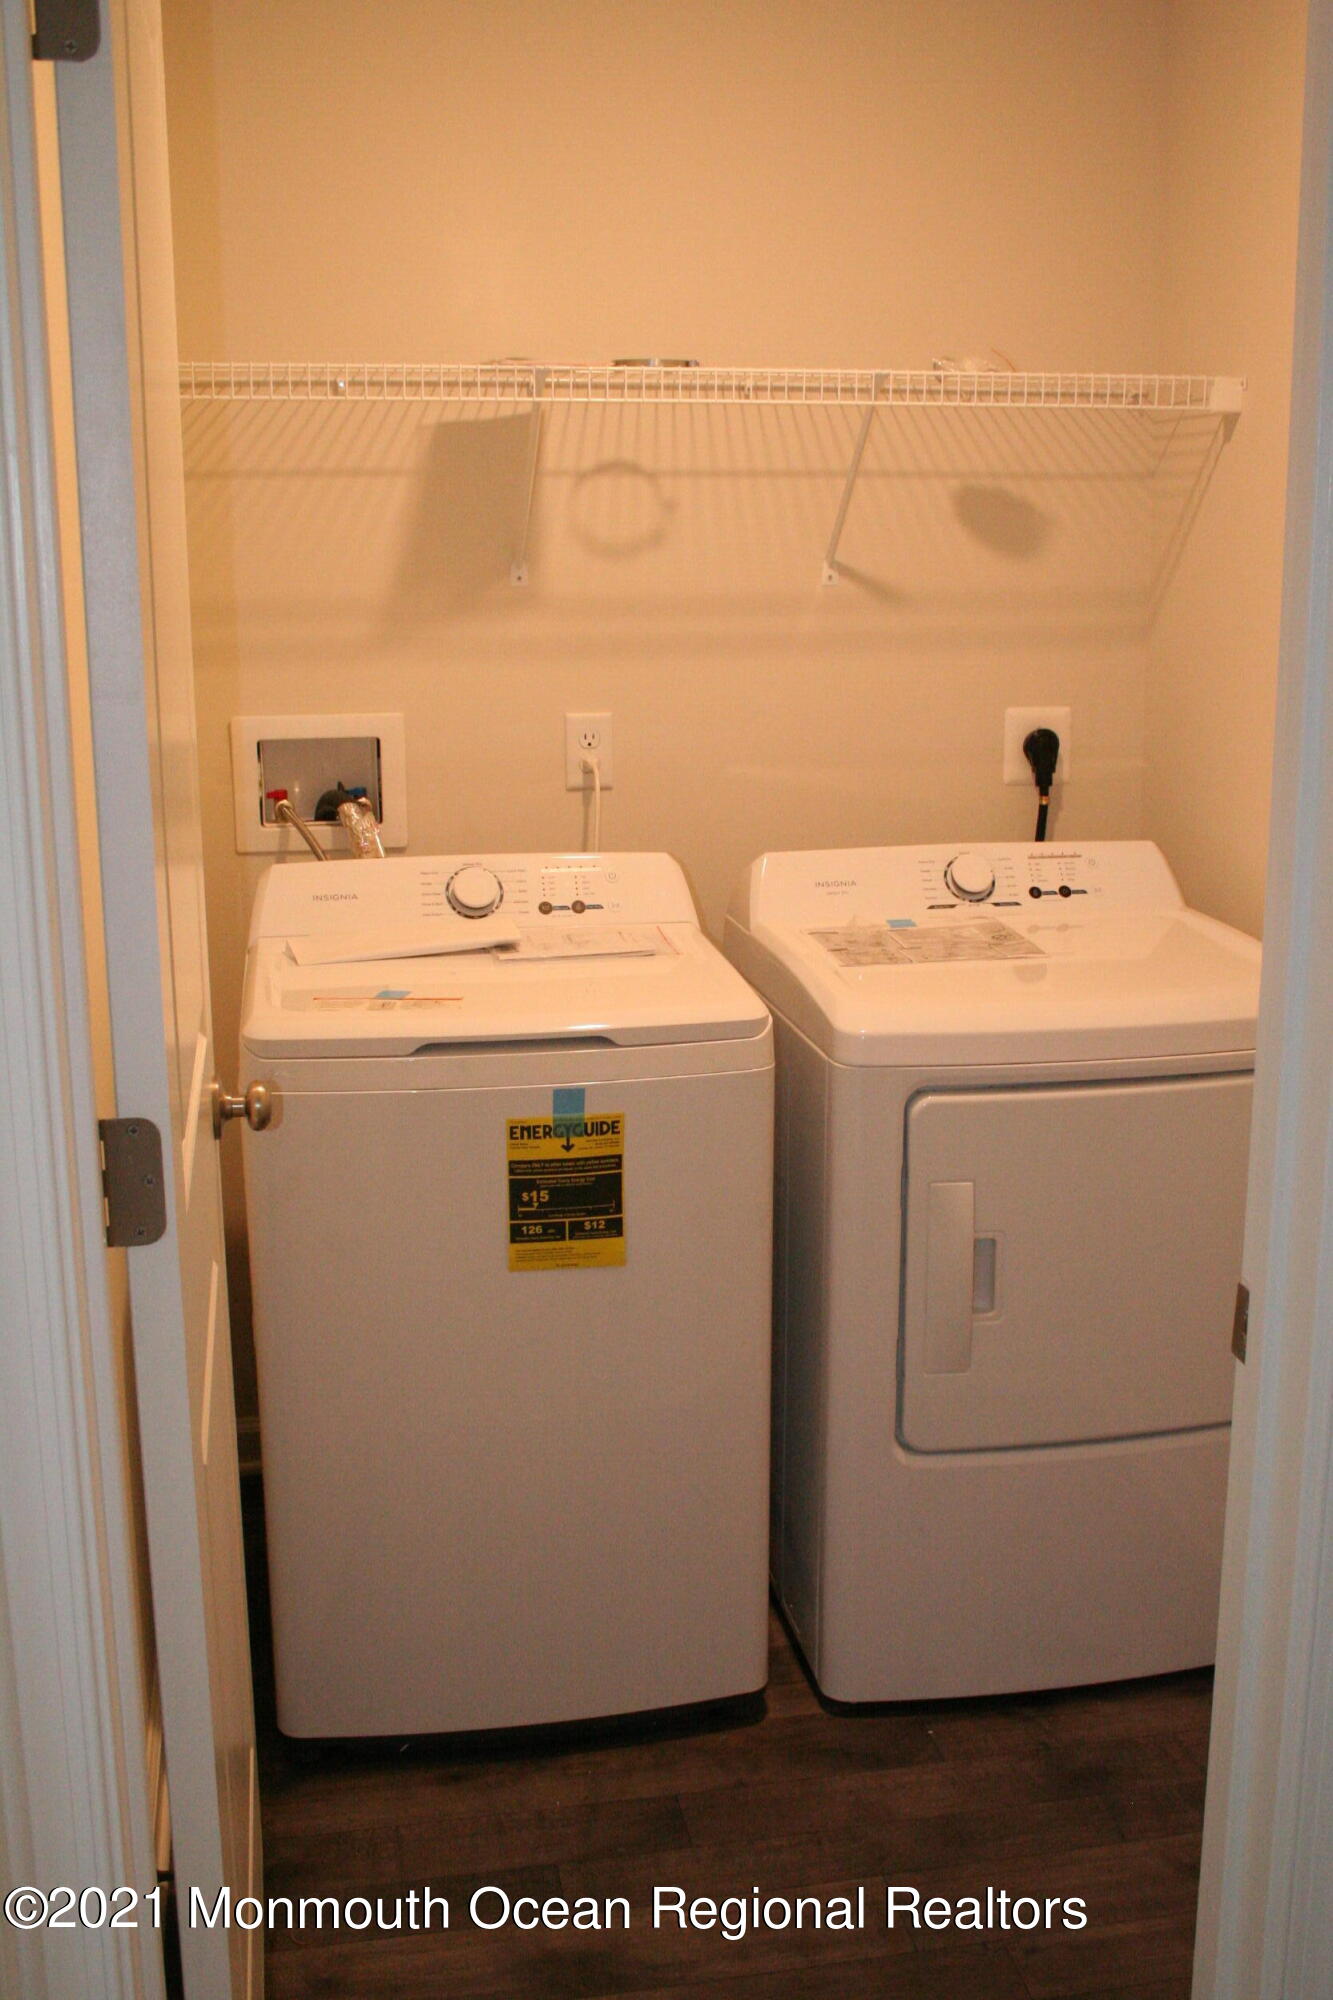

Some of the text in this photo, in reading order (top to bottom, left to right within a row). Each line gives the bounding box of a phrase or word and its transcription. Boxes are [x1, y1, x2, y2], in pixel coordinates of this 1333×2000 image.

[815, 879, 857, 888] INSIGNIA
[311, 893, 359, 902] INSIGNIA
[509, 1120, 621, 1141] ENERGYGUIDE
[521, 1189, 549, 1203] $15
[520, 1225, 543, 1236] 126
[583, 1219, 606, 1231] $12
